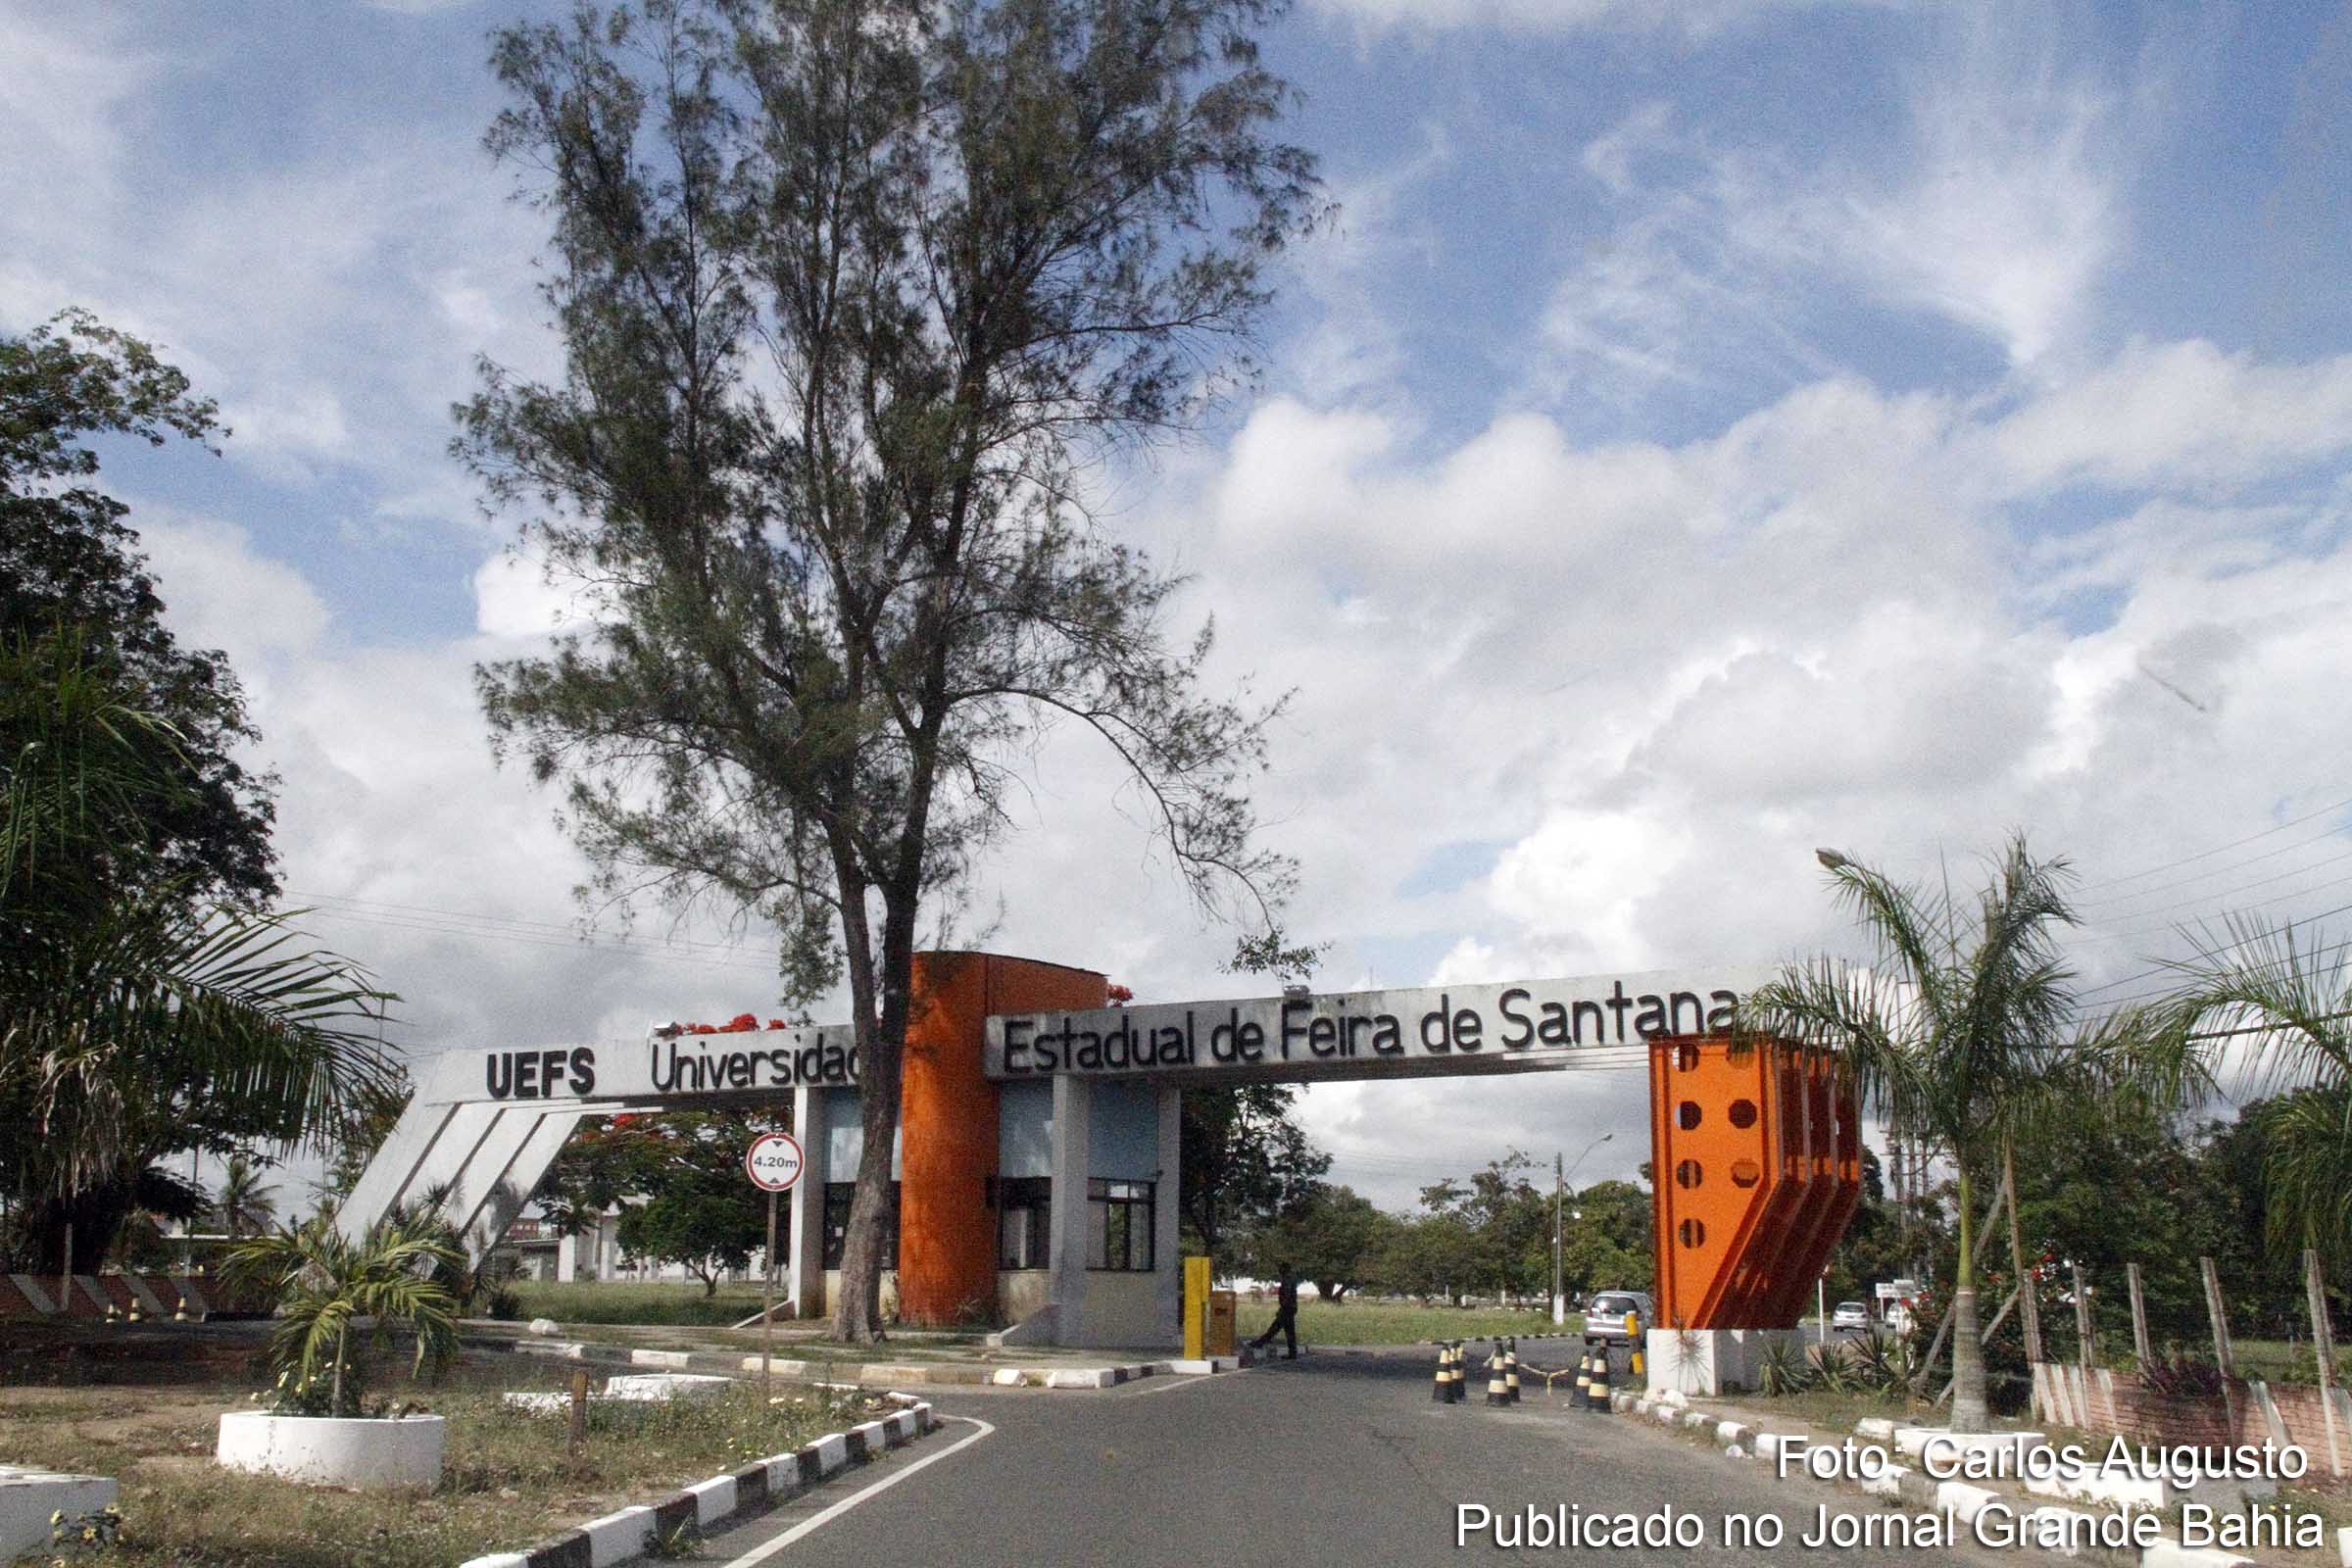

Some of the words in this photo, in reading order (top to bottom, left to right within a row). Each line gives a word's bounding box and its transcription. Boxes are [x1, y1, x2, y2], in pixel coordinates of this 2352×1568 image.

[1003, 1010, 1196, 1073] Estadual
[1210, 1007, 1264, 1062] de
[1280, 998, 1404, 1060] Feira
[1420, 993, 1484, 1054] de
[1498, 979, 1740, 1048] Santana
[486, 1047, 596, 1099] UEFS
[754, 1155, 798, 1168] 4.20m
